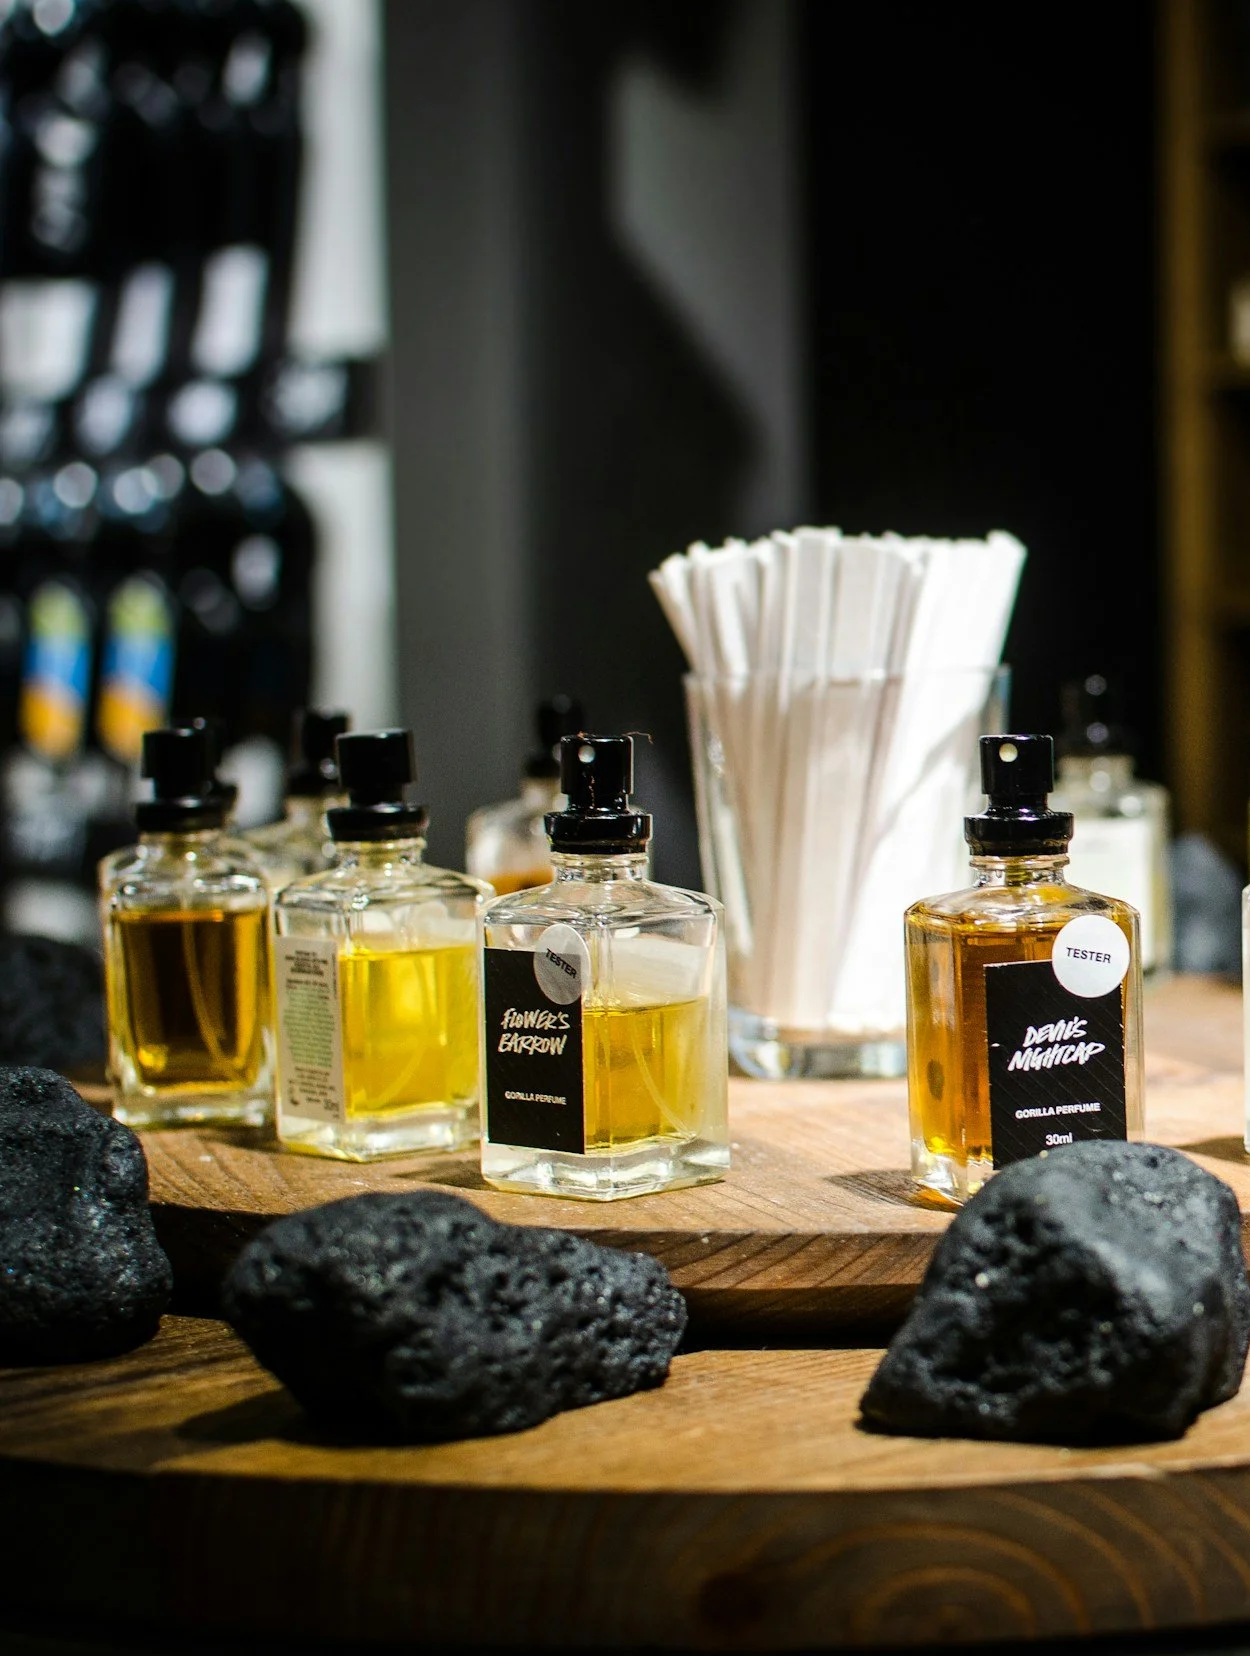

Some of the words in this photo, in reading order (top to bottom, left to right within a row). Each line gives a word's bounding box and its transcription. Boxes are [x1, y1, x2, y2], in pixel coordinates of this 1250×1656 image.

[545, 948, 577, 979] TESTER
[1066, 947, 1112, 964] TESTER
[1023, 1016, 1088, 1047] DEVIL'S
[498, 1033, 567, 1055] BARROW
[1008, 1042, 1105, 1071] NIGHTCAP
[504, 1090, 535, 1102] GORILLA
[535, 1094, 567, 1106] PERFUME
[1015, 1107, 1055, 1120] GORILLA
[1056, 1102, 1101, 1116] PERFUME
[1045, 1132, 1073, 1146] 30ml
